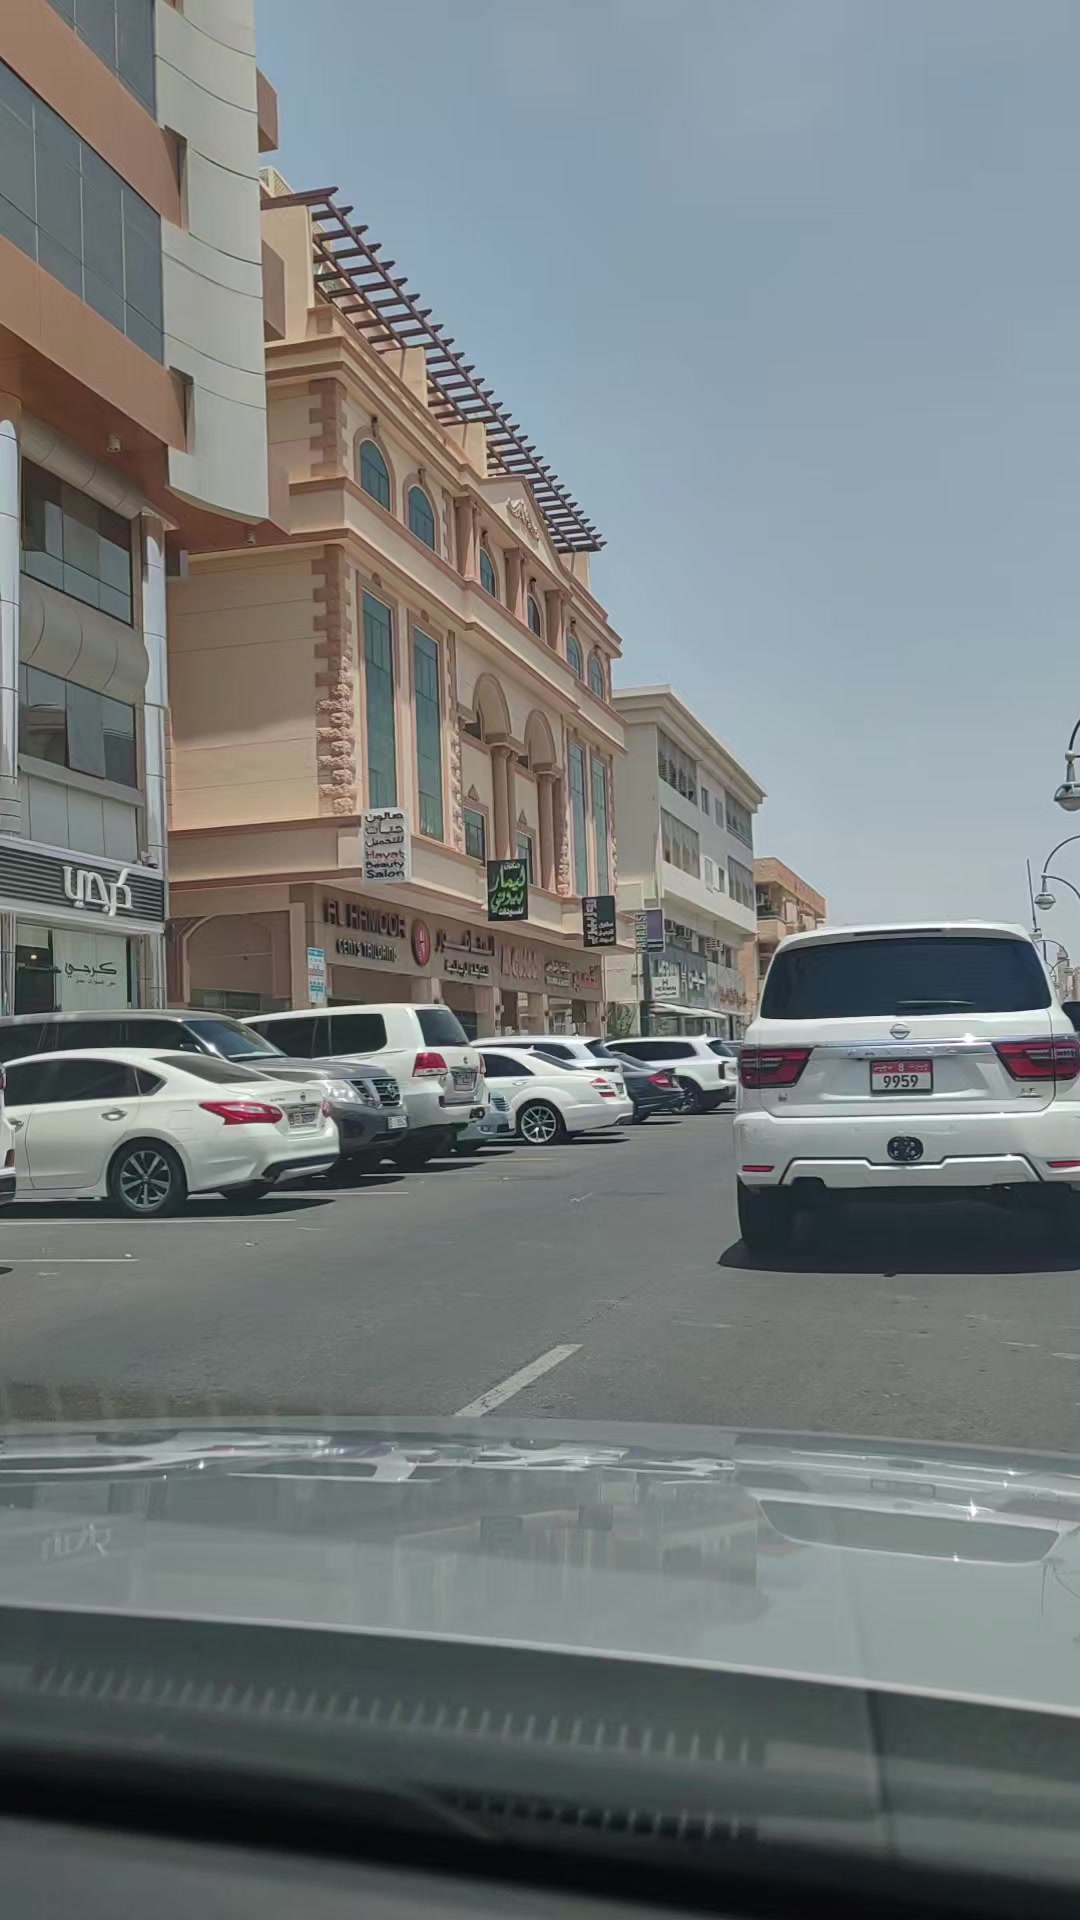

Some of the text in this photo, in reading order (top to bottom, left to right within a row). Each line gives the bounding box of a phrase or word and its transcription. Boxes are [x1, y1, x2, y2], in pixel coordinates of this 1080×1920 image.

[365, 850, 404, 860] Hayat
[365, 861, 404, 869] Beauty
[366, 869, 405, 879] Salon
[336, 938, 362, 957] GENTS
[64, 961, 118, 978] كرجي
[883, 1074, 919, 1088] 9959
